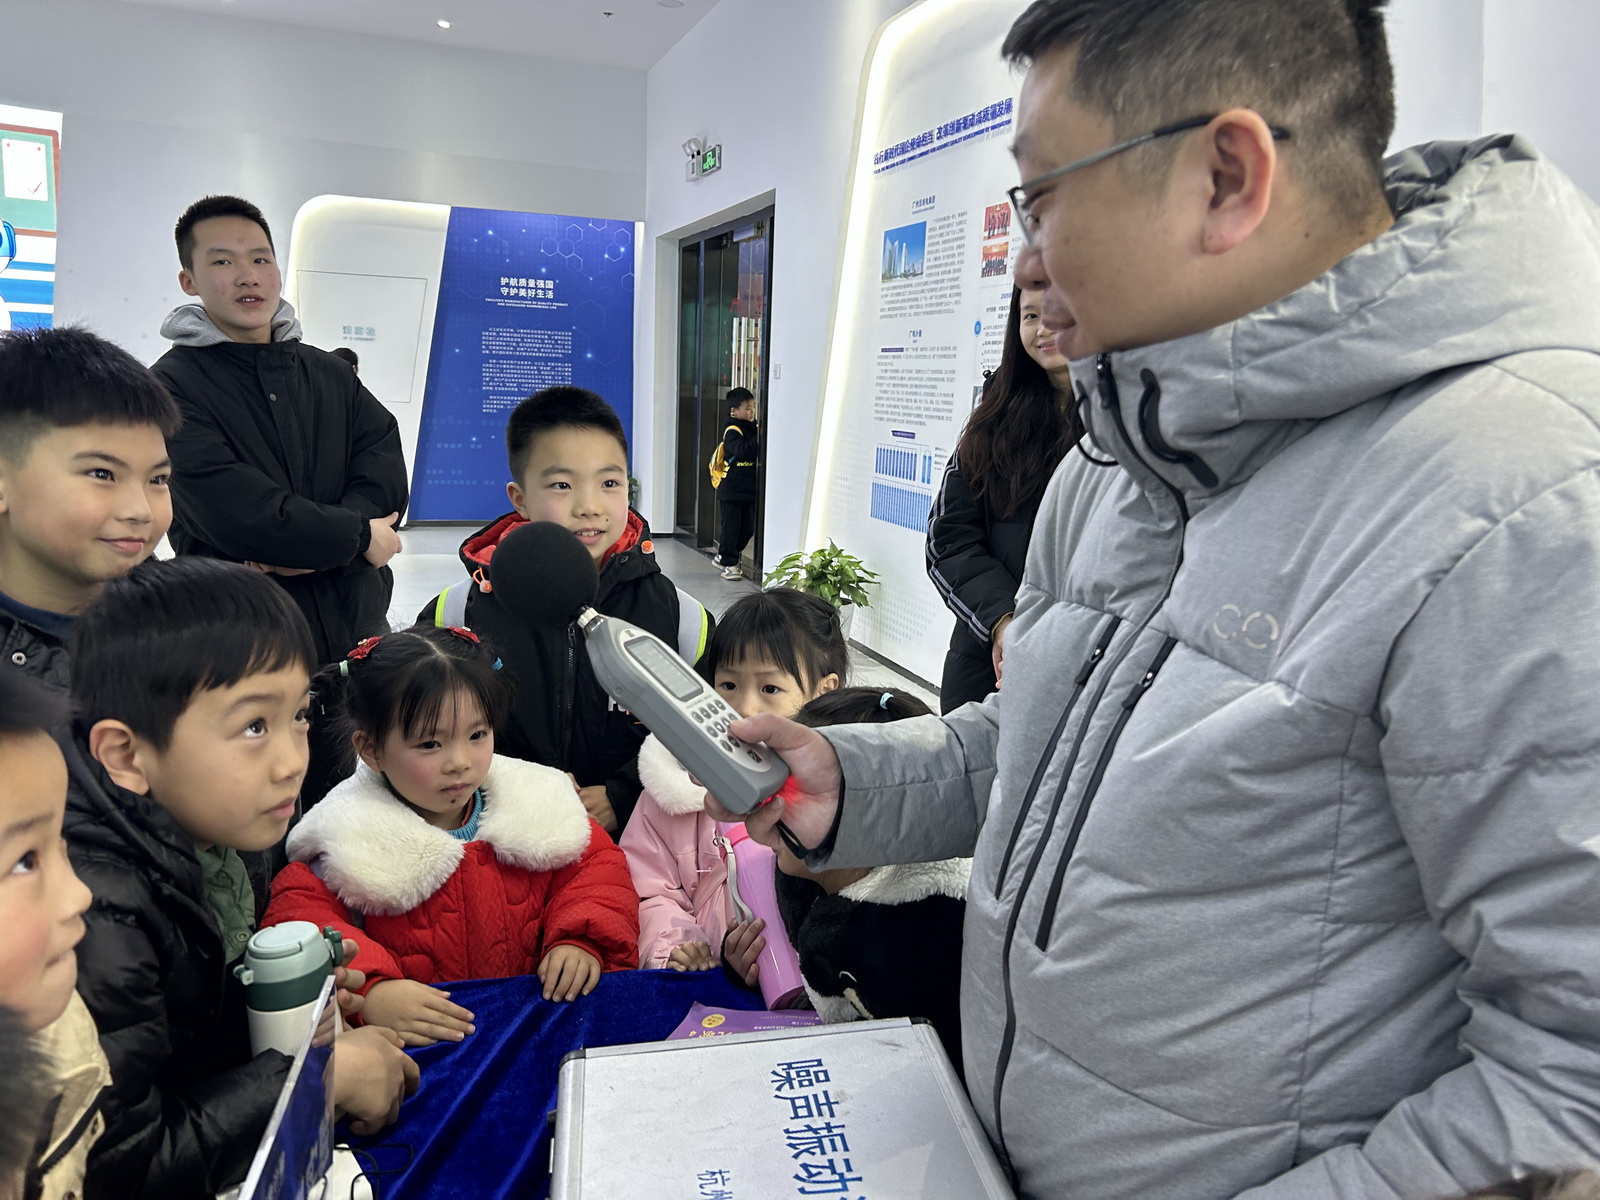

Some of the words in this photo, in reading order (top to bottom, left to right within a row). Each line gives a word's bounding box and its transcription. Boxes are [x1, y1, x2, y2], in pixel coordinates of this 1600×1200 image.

[936, 97, 1013, 140] 改革创新驱动高质量发展
[500, 276, 554, 289] 护航质量强国
[500, 287, 554, 299] 守护美好生活
[770, 1058, 867, 1200] 噪声振动
